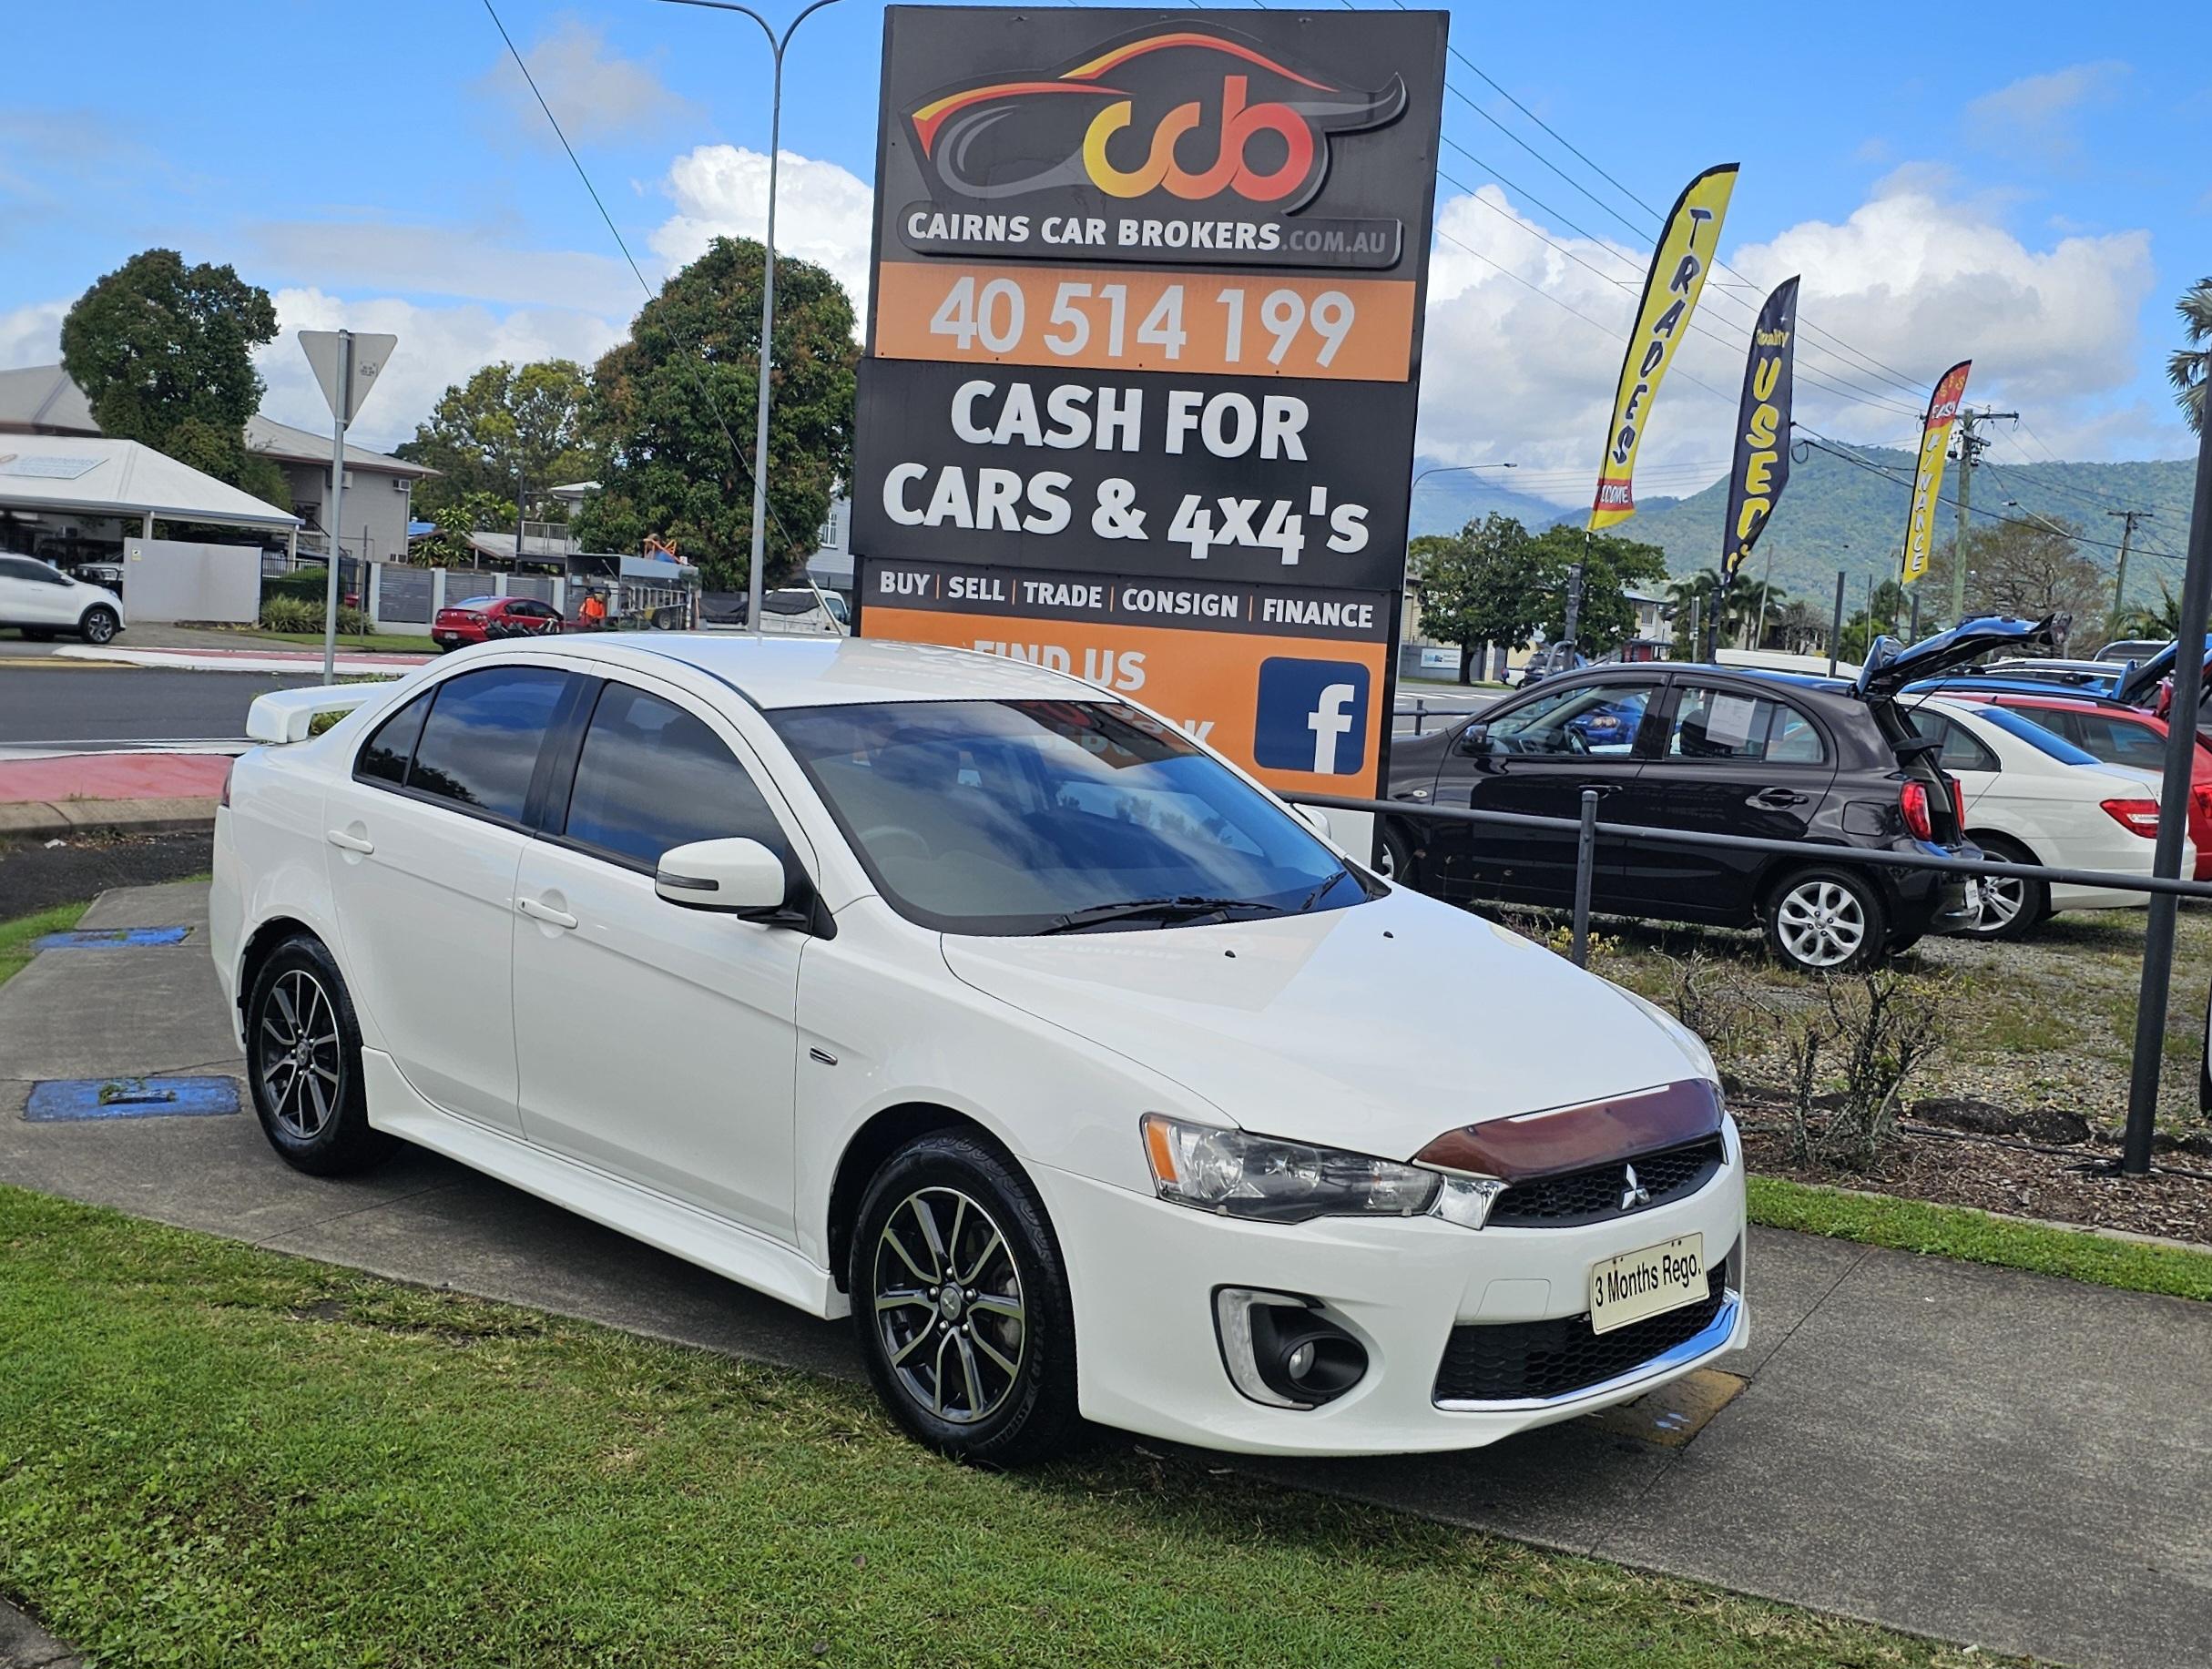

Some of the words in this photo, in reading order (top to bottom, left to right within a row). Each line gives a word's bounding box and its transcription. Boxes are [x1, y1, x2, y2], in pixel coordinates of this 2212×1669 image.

[907, 211, 1030, 242] CAIRNS
[1041, 216, 1106, 246] CAR
[930, 276, 1026, 353] 40
[1044, 282, 1187, 360] 514
[1216, 289, 1356, 368] 199
[1613, 208, 1712, 464] TRADES
[951, 380, 1143, 452] CASH
[1165, 390, 1310, 461] FOR
[882, 462, 1073, 534] CARS
[1091, 477, 1149, 540] &
[880, 570, 931, 596] BUY
[947, 575, 1005, 602] SELL
[1023, 581, 1103, 608] TRADE
[1121, 588, 1239, 618] CONSIGN
[1262, 598, 1373, 628] FINANCE
[1084, 647, 1147, 691] US
[1595, 1275, 1605, 1308] 3
[1606, 1261, 1659, 1304] Months
[1662, 1253, 1702, 1288] Rego.
